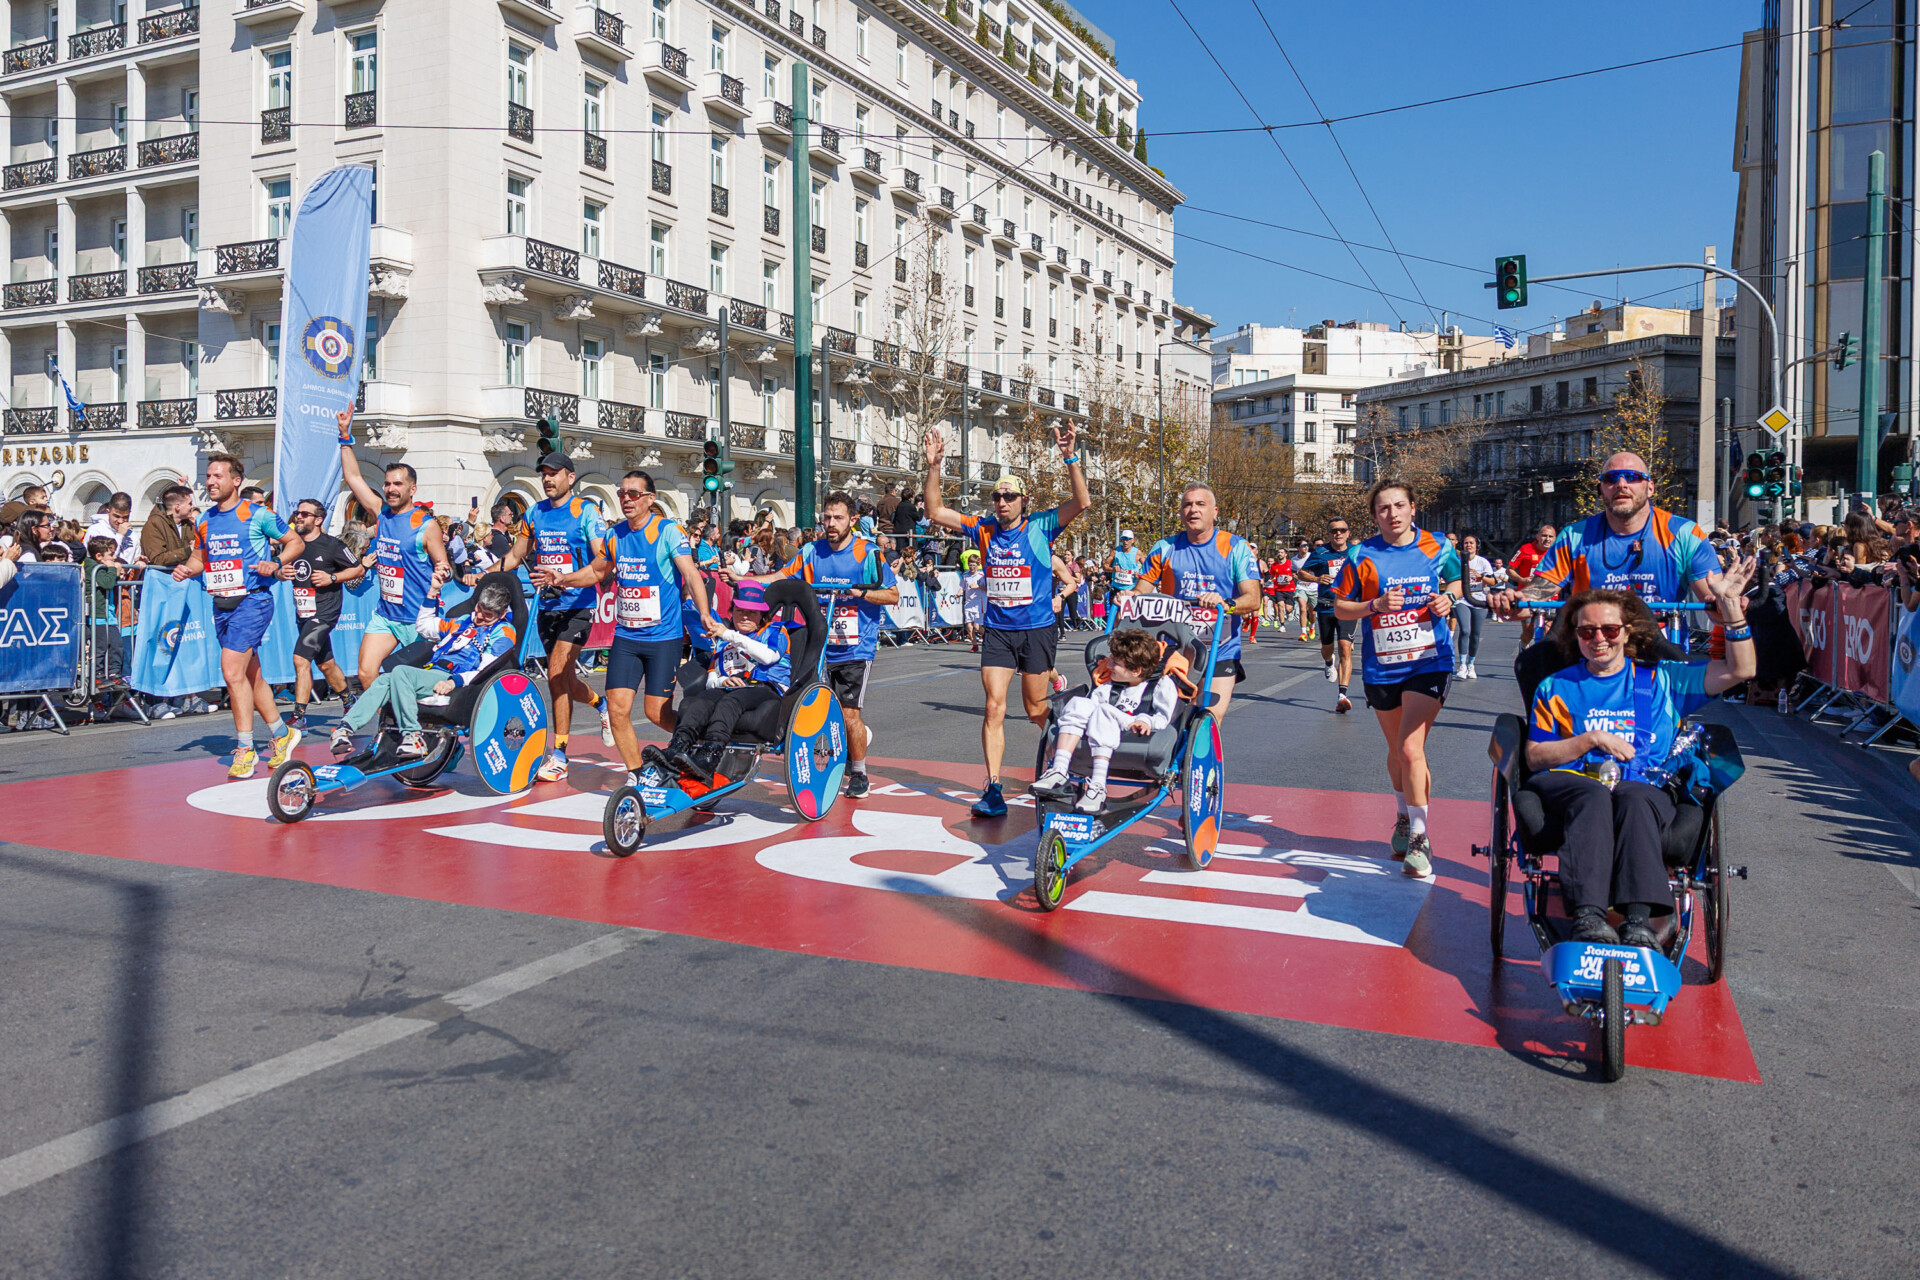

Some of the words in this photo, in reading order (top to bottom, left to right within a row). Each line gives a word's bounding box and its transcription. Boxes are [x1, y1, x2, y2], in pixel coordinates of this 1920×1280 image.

[541, 555, 563, 564] ERGO
[210, 560, 234, 571] ERGO
[992, 567, 1021, 577] ERGO
[213, 573, 234, 584] 3613
[1386, 576, 1430, 586] Stoiximan
[995, 581, 1020, 591] 1177
[619, 588, 641, 598] RGO
[820, 606, 848, 617] EGO
[1193, 610, 1211, 620] GO
[1379, 610, 1418, 627] ERGO
[1386, 628, 1418, 643] 4337
[1584, 717, 1635, 732] Whee
[1584, 945, 1637, 959] Stoiximan
[1580, 955, 1640, 973] Whls
[1583, 968, 1646, 986] Chge
